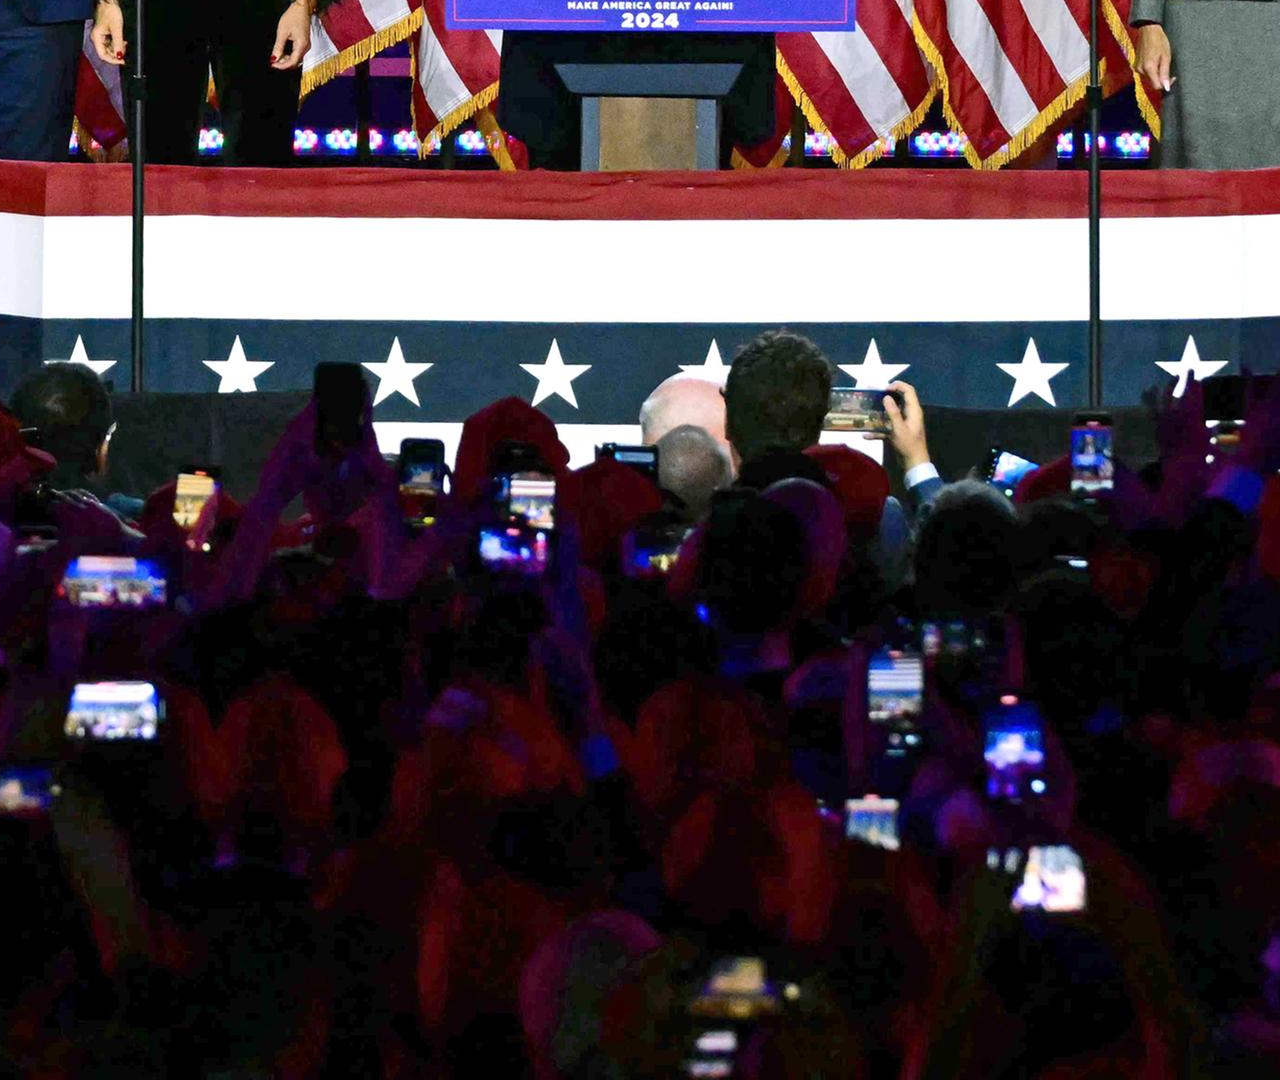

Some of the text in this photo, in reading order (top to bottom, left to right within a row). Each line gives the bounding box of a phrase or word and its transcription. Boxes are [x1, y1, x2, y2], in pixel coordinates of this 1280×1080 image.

[567, 1, 734, 11] MAKE AMERICA GREAT AGAIN!
[620, 12, 680, 29] 2024
